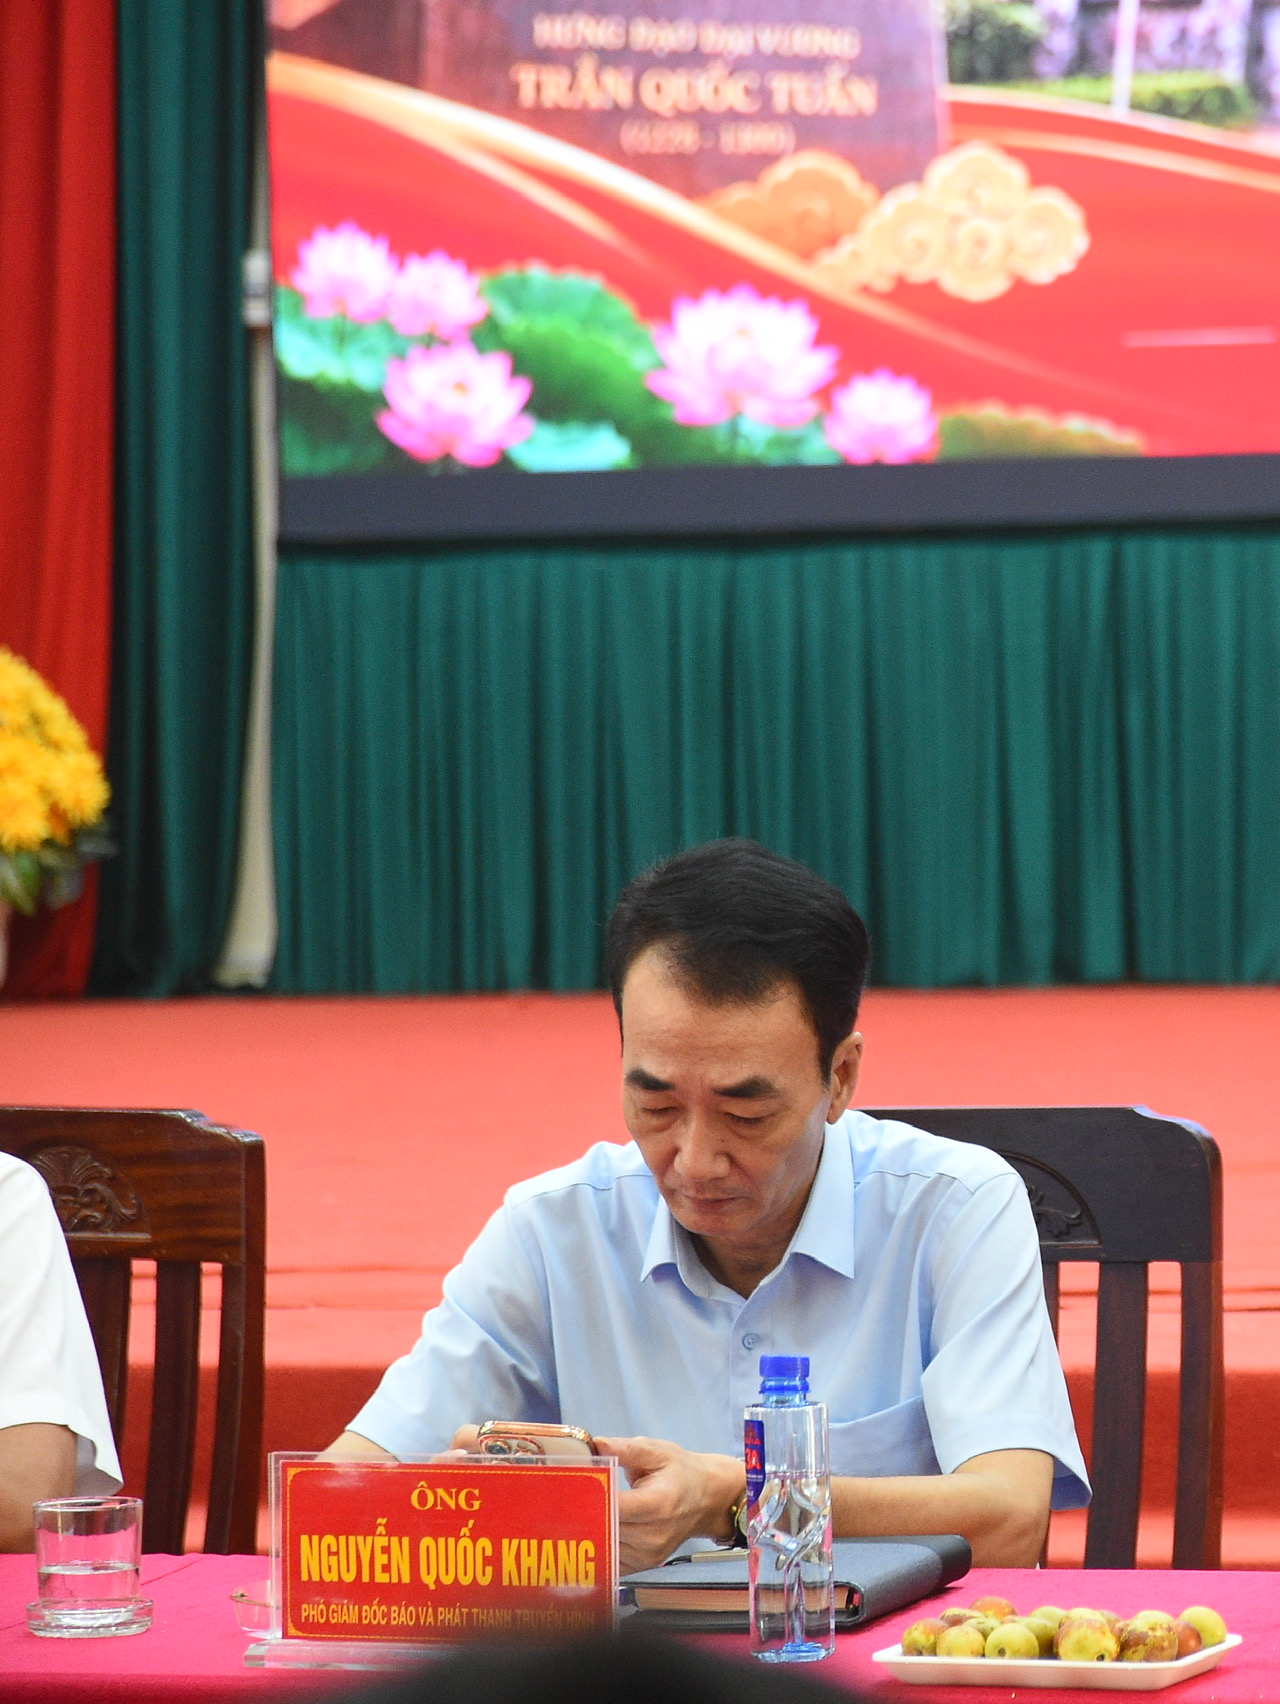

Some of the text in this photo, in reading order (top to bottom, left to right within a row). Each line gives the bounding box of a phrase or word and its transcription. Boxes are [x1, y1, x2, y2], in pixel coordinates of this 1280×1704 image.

[510, 53, 879, 117] TRẦN QUỐC TUẤN
[411, 1481, 482, 1511] ÔNG
[301, 1517, 596, 1590] NGUYỄN QUỐC KHANG
[301, 1599, 327, 1624] PHÓ
[329, 1600, 359, 1624] GIÁM
[362, 1598, 388, 1625] ĐỐC
[390, 1601, 416, 1626] BÁO
[418, 1602, 435, 1626] VÀ
[437, 1603, 469, 1627] PHÁT
[471, 1608, 512, 1627] THANH
